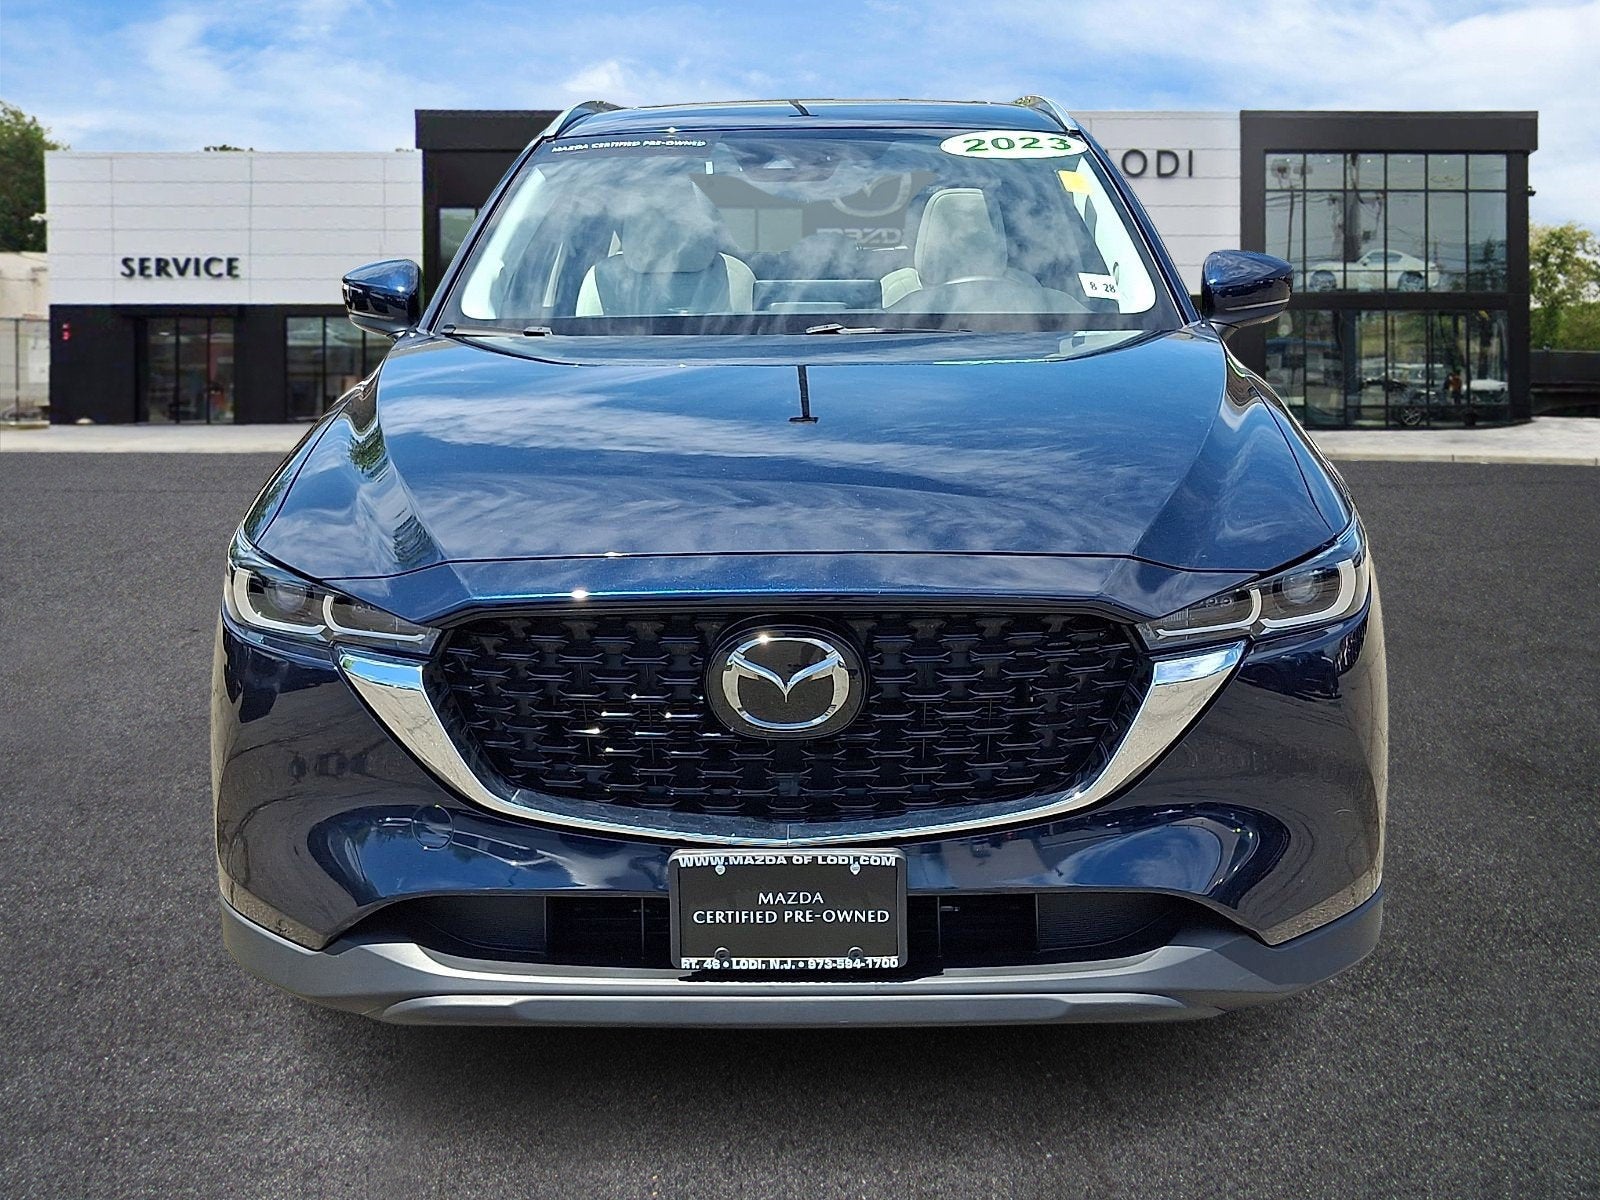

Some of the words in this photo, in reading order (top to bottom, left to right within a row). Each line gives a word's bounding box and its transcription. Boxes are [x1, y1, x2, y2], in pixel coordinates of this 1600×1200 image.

[551, 142, 589, 153] MAZDA
[591, 141, 641, 149] CERTIFIED
[643, 139, 707, 148] PRE-OWNED
[963, 137, 1072, 152] 2023
[1105, 149, 1193, 177] ODI
[120, 257, 240, 278] SERVICE
[1102, 283, 1116, 293] 28
[679, 855, 788, 868] WWW.MAZDA
[792, 855, 812, 865] OF
[817, 855, 897, 867] LODI.COM
[757, 891, 825, 905] MAZDA
[692, 910, 778, 924] CERTIFIED
[784, 909, 890, 923] PRE-OWNED
[681, 959, 700, 969] RT.
[770, 959, 796, 970] N.J.
[807, 958, 899, 970] 973-594-1700
